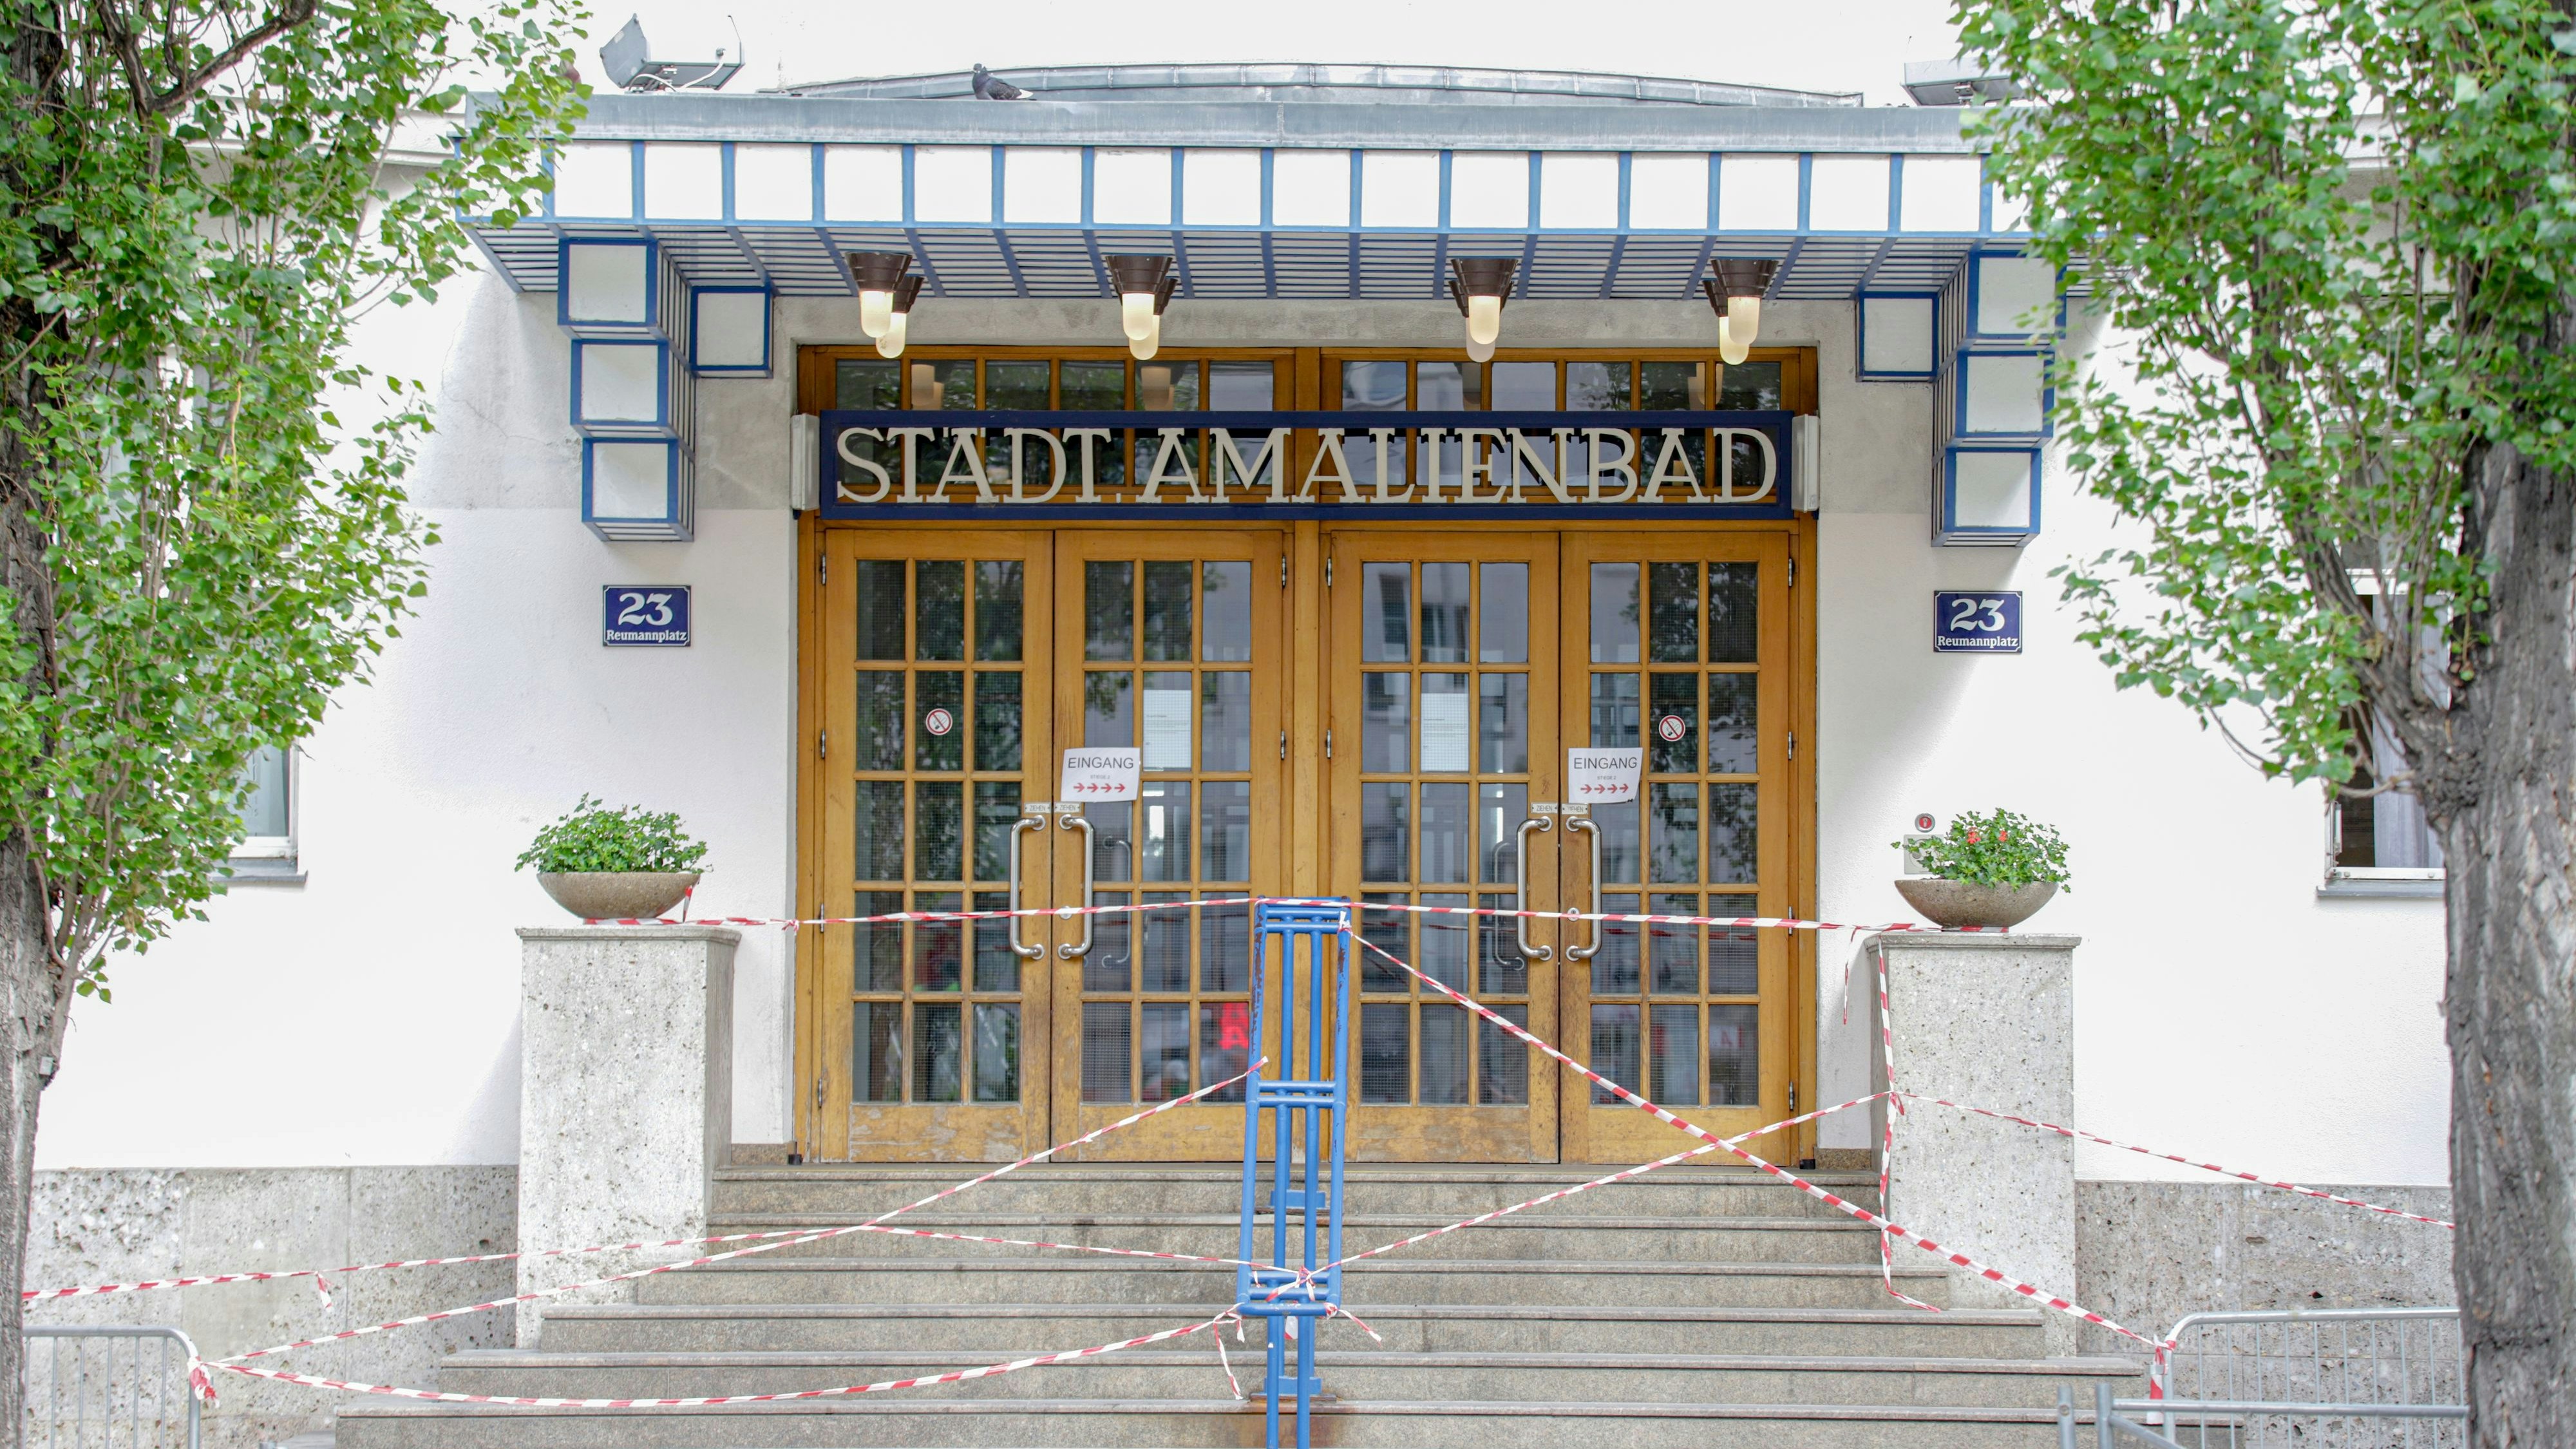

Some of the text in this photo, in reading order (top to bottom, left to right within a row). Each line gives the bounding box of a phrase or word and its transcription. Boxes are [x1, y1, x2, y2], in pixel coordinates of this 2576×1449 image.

[1135, 427, 1777, 504] AMALIENBAD
[618, 592, 673, 626] 23
[1950, 598, 2005, 631] 23
[607, 630, 687, 643] Reumannplatz
[1937, 636, 2018, 649] Reumannplatz
[1068, 757, 1134, 769] EINGANG
[1573, 757, 1638, 770] EINGANG
